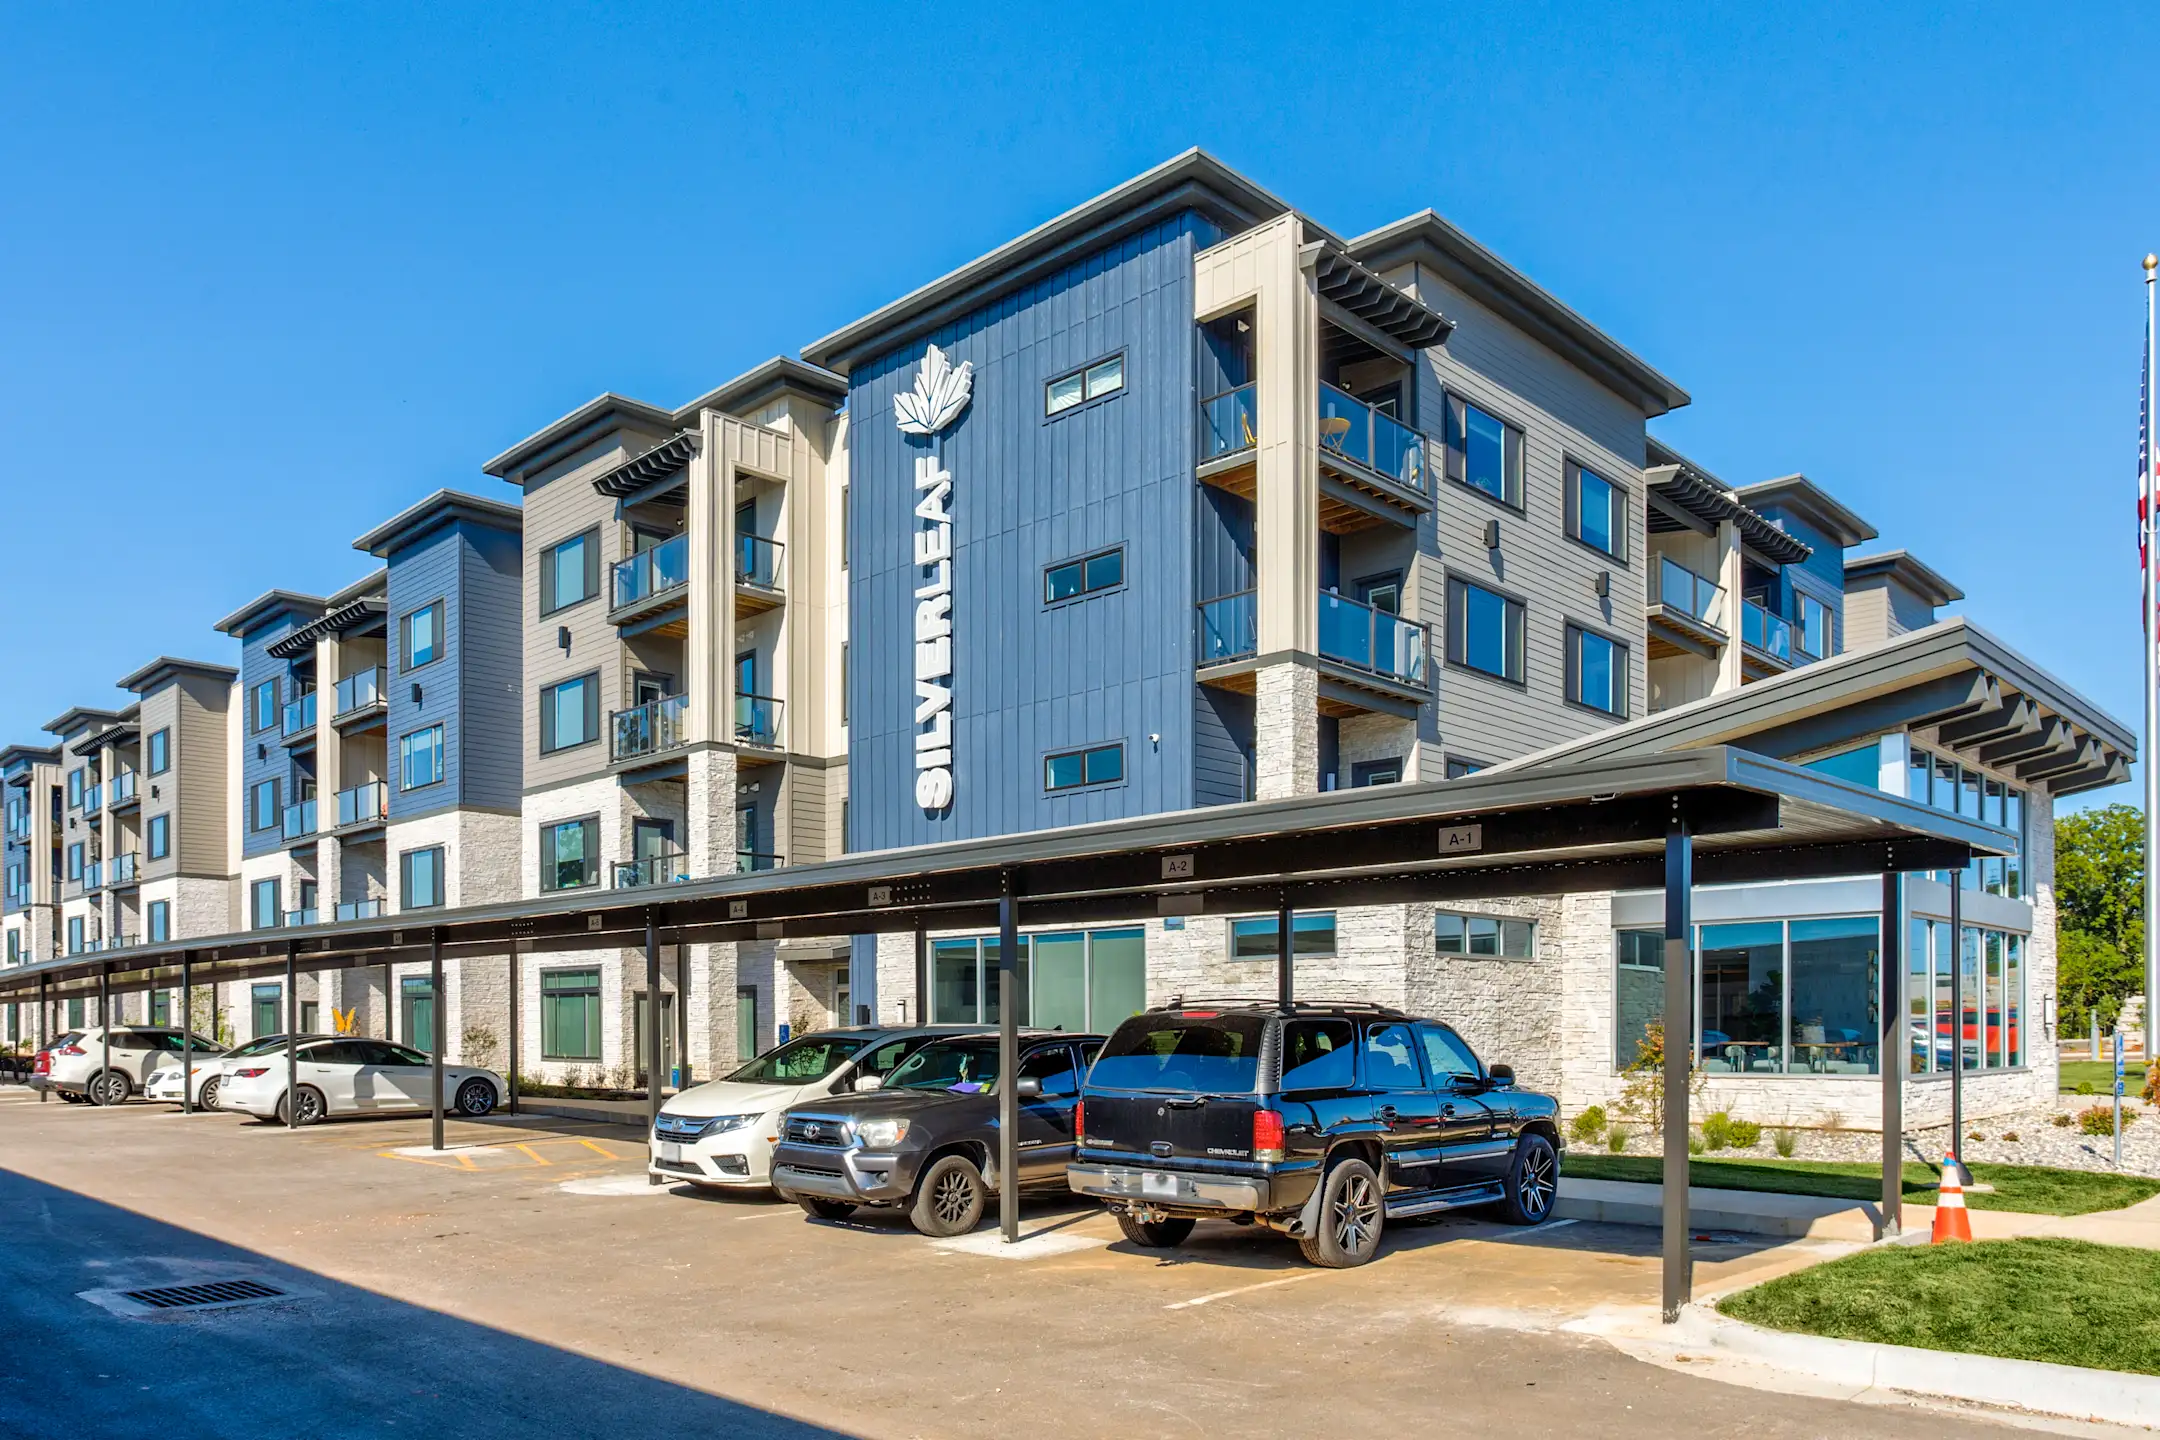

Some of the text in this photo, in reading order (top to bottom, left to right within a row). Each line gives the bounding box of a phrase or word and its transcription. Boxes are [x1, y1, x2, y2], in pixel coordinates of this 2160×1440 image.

[915, 455, 952, 809] SILVERLEAF
[1449, 831, 1472, 846] A-1
[1168, 860, 1188, 873] A-2
[873, 891, 886, 900] A-3
[733, 904, 744, 913] A-4
[1206, 1147, 1250, 1157] CHEVROLET
